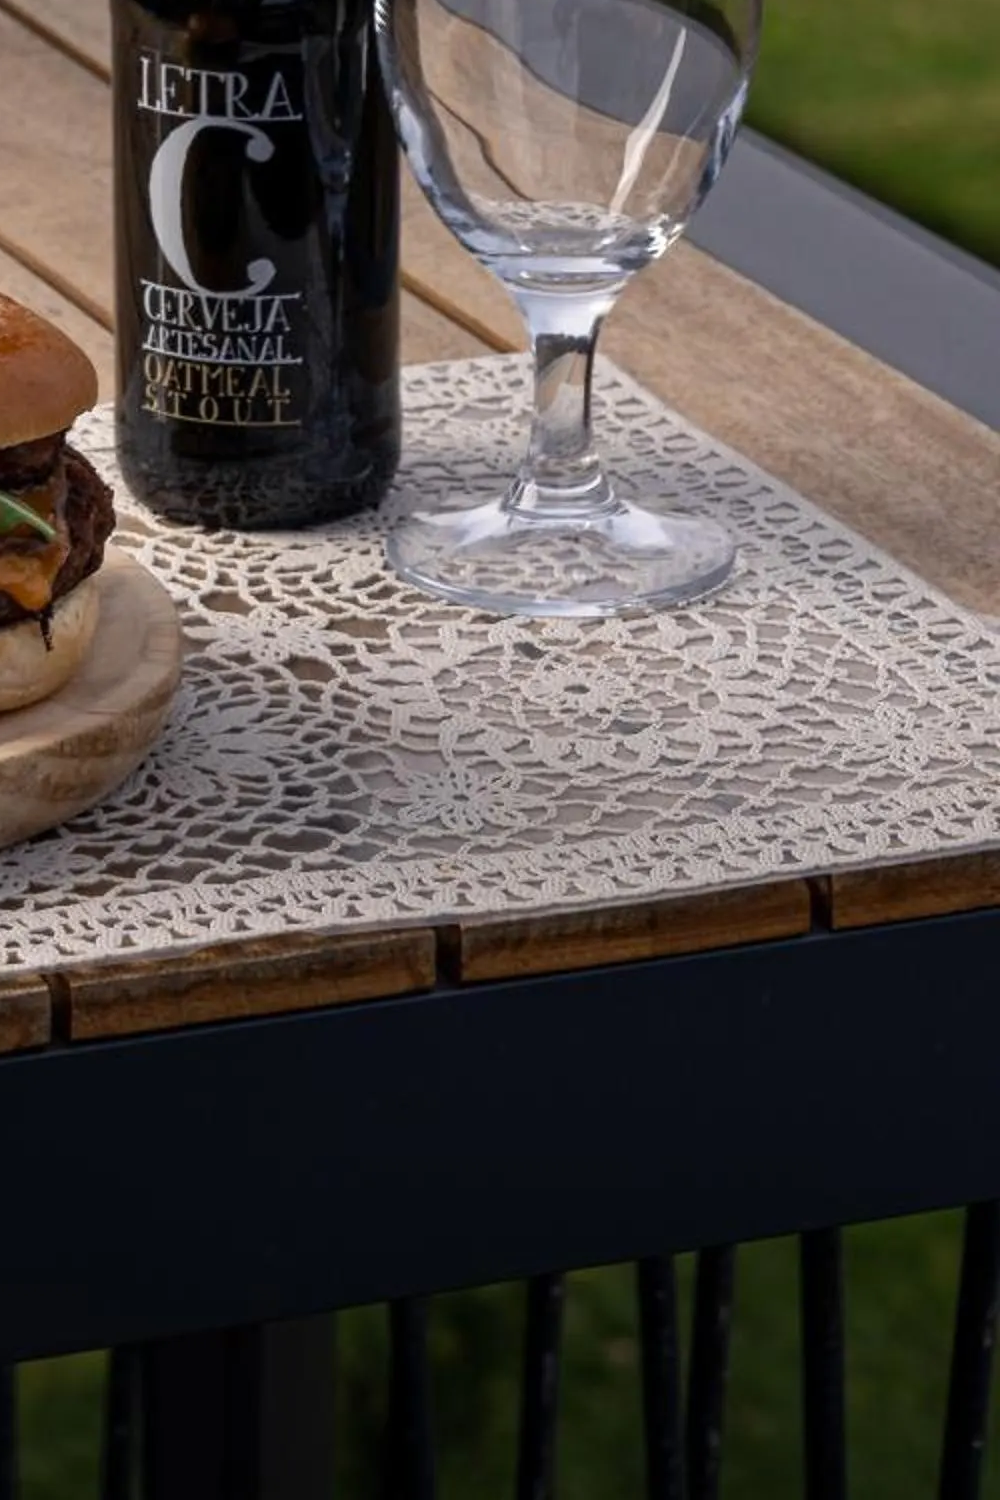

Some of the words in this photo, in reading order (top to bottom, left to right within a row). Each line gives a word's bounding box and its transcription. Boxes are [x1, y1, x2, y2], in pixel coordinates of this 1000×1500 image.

[138, 56, 302, 121] LETRA
[149, 117, 276, 298] C
[142, 281, 292, 333] CERVEJA
[143, 324, 293, 364] ARTESANAL
[144, 353, 291, 397] OATMEAL
[144, 383, 291, 424] STOUT
